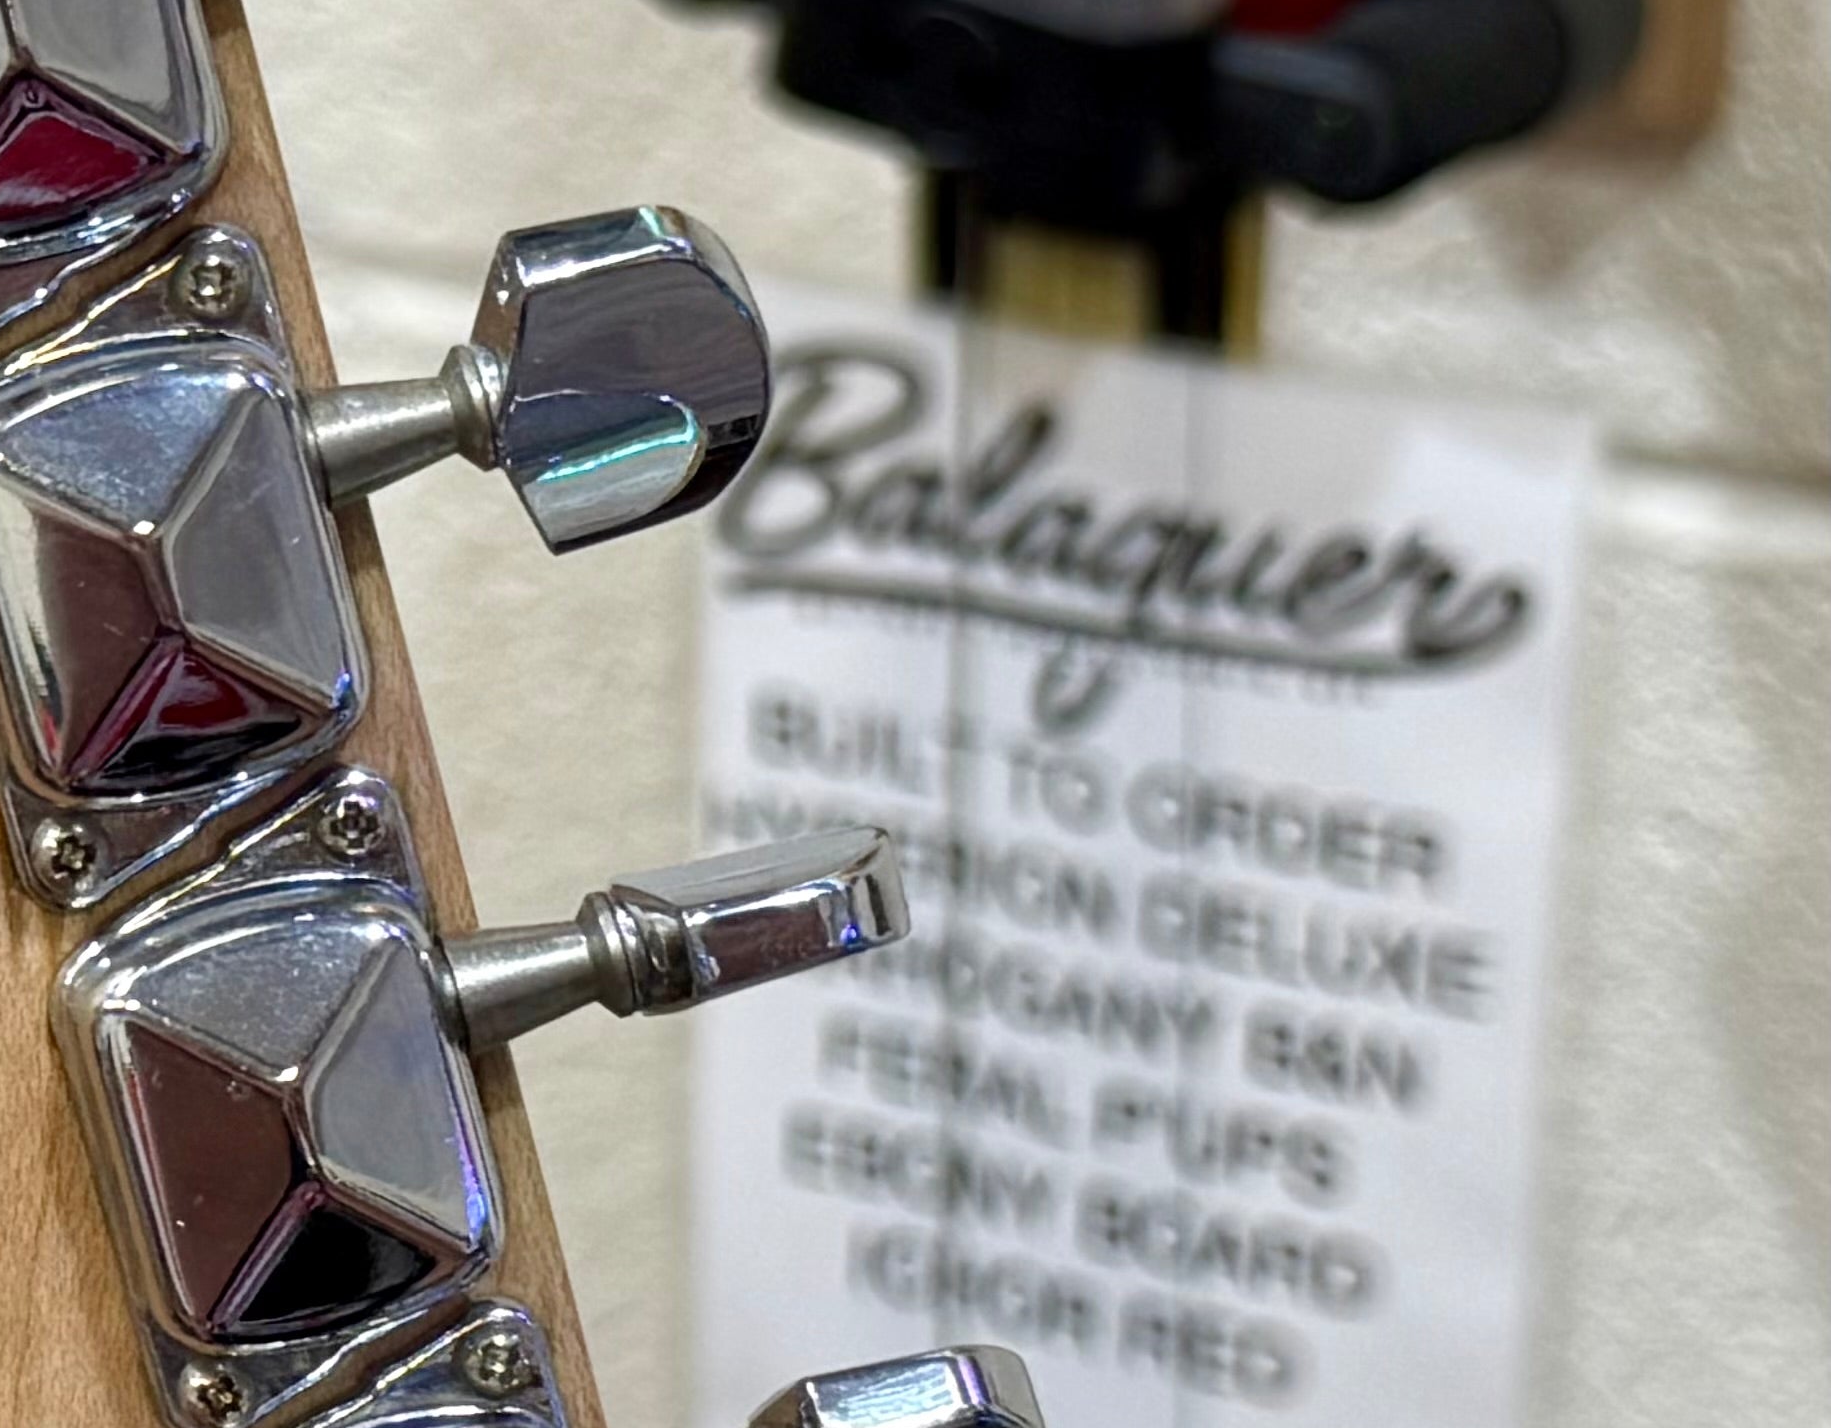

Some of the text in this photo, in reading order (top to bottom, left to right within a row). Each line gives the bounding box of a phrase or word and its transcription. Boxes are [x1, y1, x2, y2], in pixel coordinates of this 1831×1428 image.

[718, 337, 1530, 724] Balaguer
[752, 684, 1446, 890] BUILT TO ORDER
[1138, 872, 1496, 1014] DELUXE
[820, 1007, 1070, 1147] FERAL
[781, 1100, 1387, 1319] EBONY BOARD
[1119, 1293, 1313, 1405] RED
